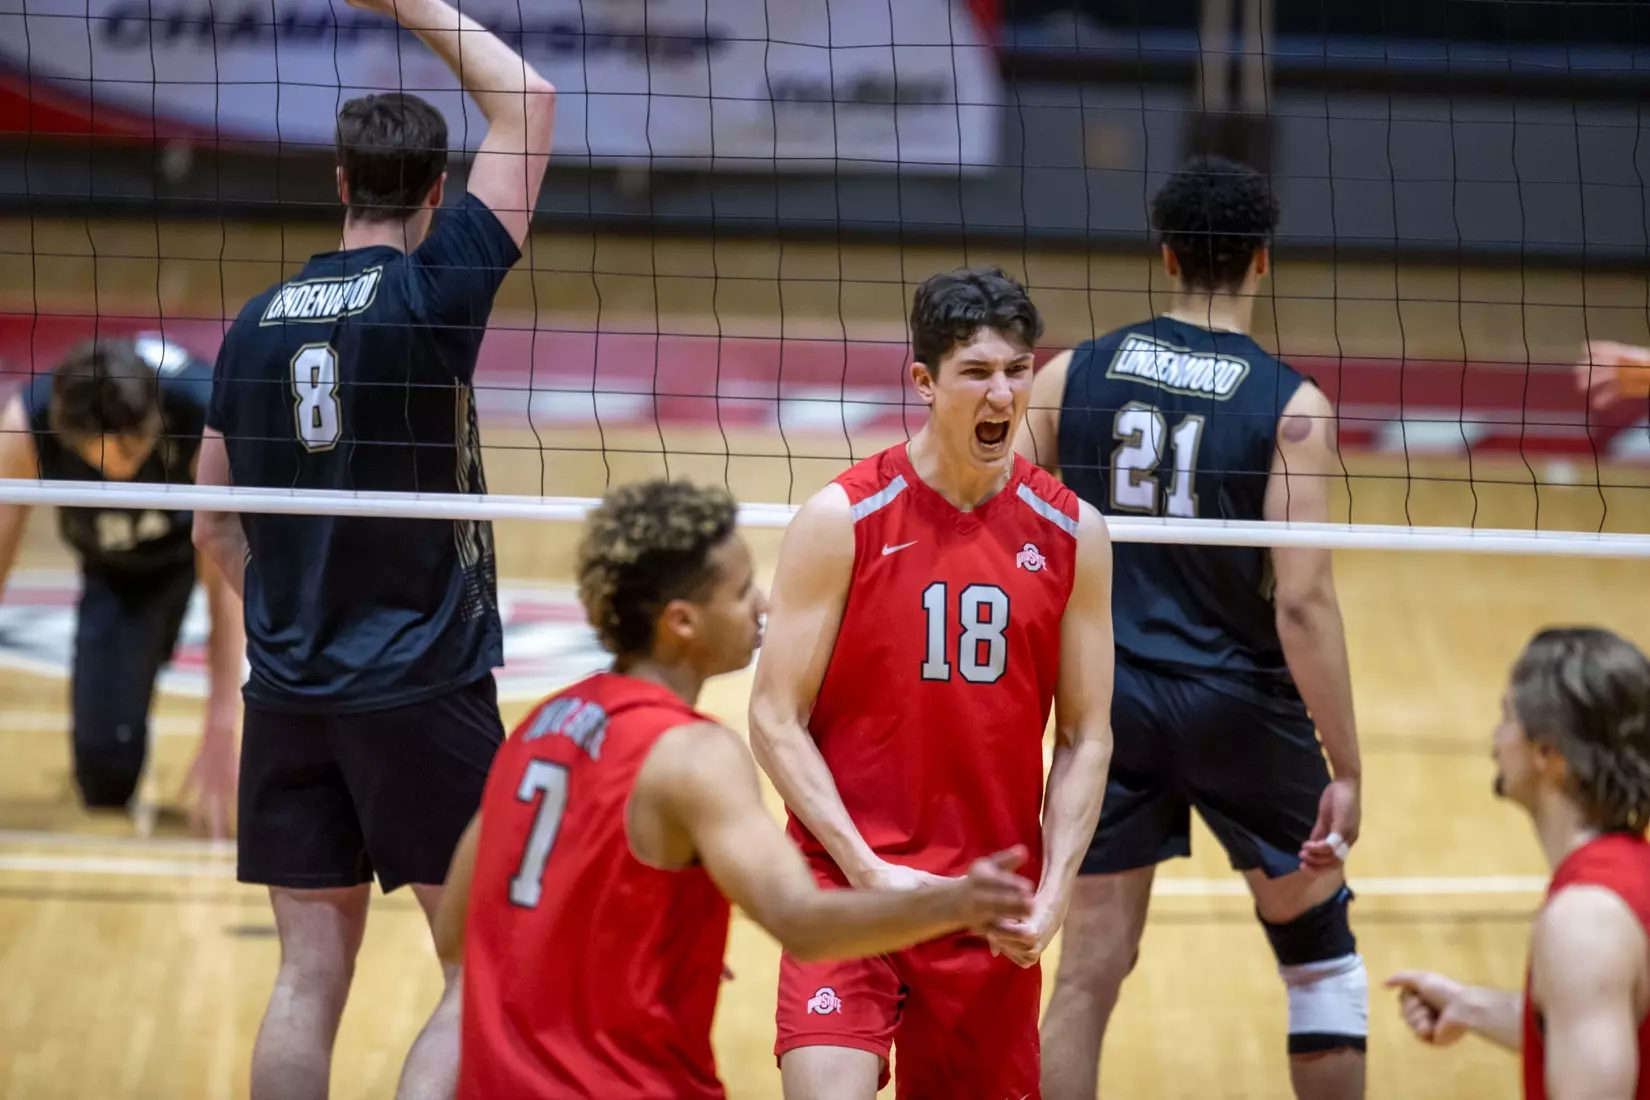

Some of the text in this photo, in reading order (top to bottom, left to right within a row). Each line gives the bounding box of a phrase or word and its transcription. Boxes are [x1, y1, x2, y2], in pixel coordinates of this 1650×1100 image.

[265, 272, 379, 320] LINDENWO
[290, 342, 342, 454] 8
[1114, 338, 1244, 396] LINDENWOOD
[1110, 401, 1206, 518] 21
[921, 581, 1010, 684] 18
[509, 757, 570, 909] 7
